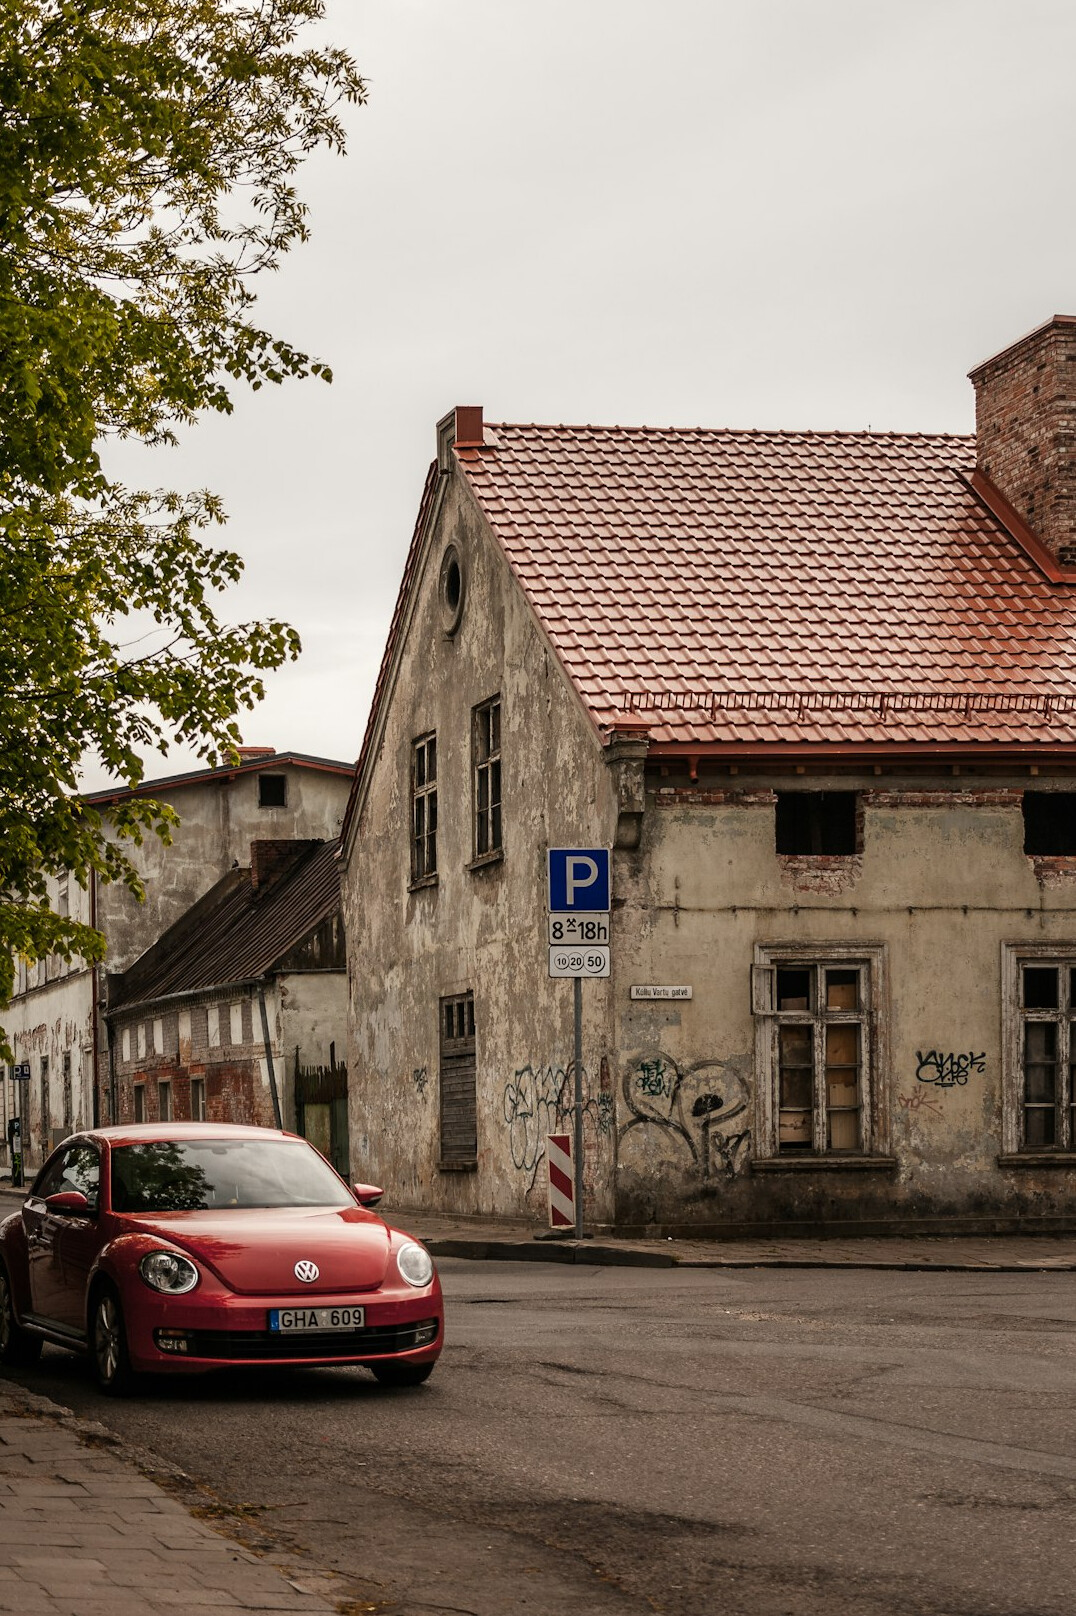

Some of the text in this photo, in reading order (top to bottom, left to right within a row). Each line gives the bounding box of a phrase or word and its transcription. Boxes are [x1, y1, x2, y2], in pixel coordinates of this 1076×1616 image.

[566, 856, 598, 905] P
[557, 956, 602, 967] 10 20 50
[14, 1066, 21, 1079] P
[281, 1311, 319, 1328] GHA
[330, 1309, 362, 1326] 609
